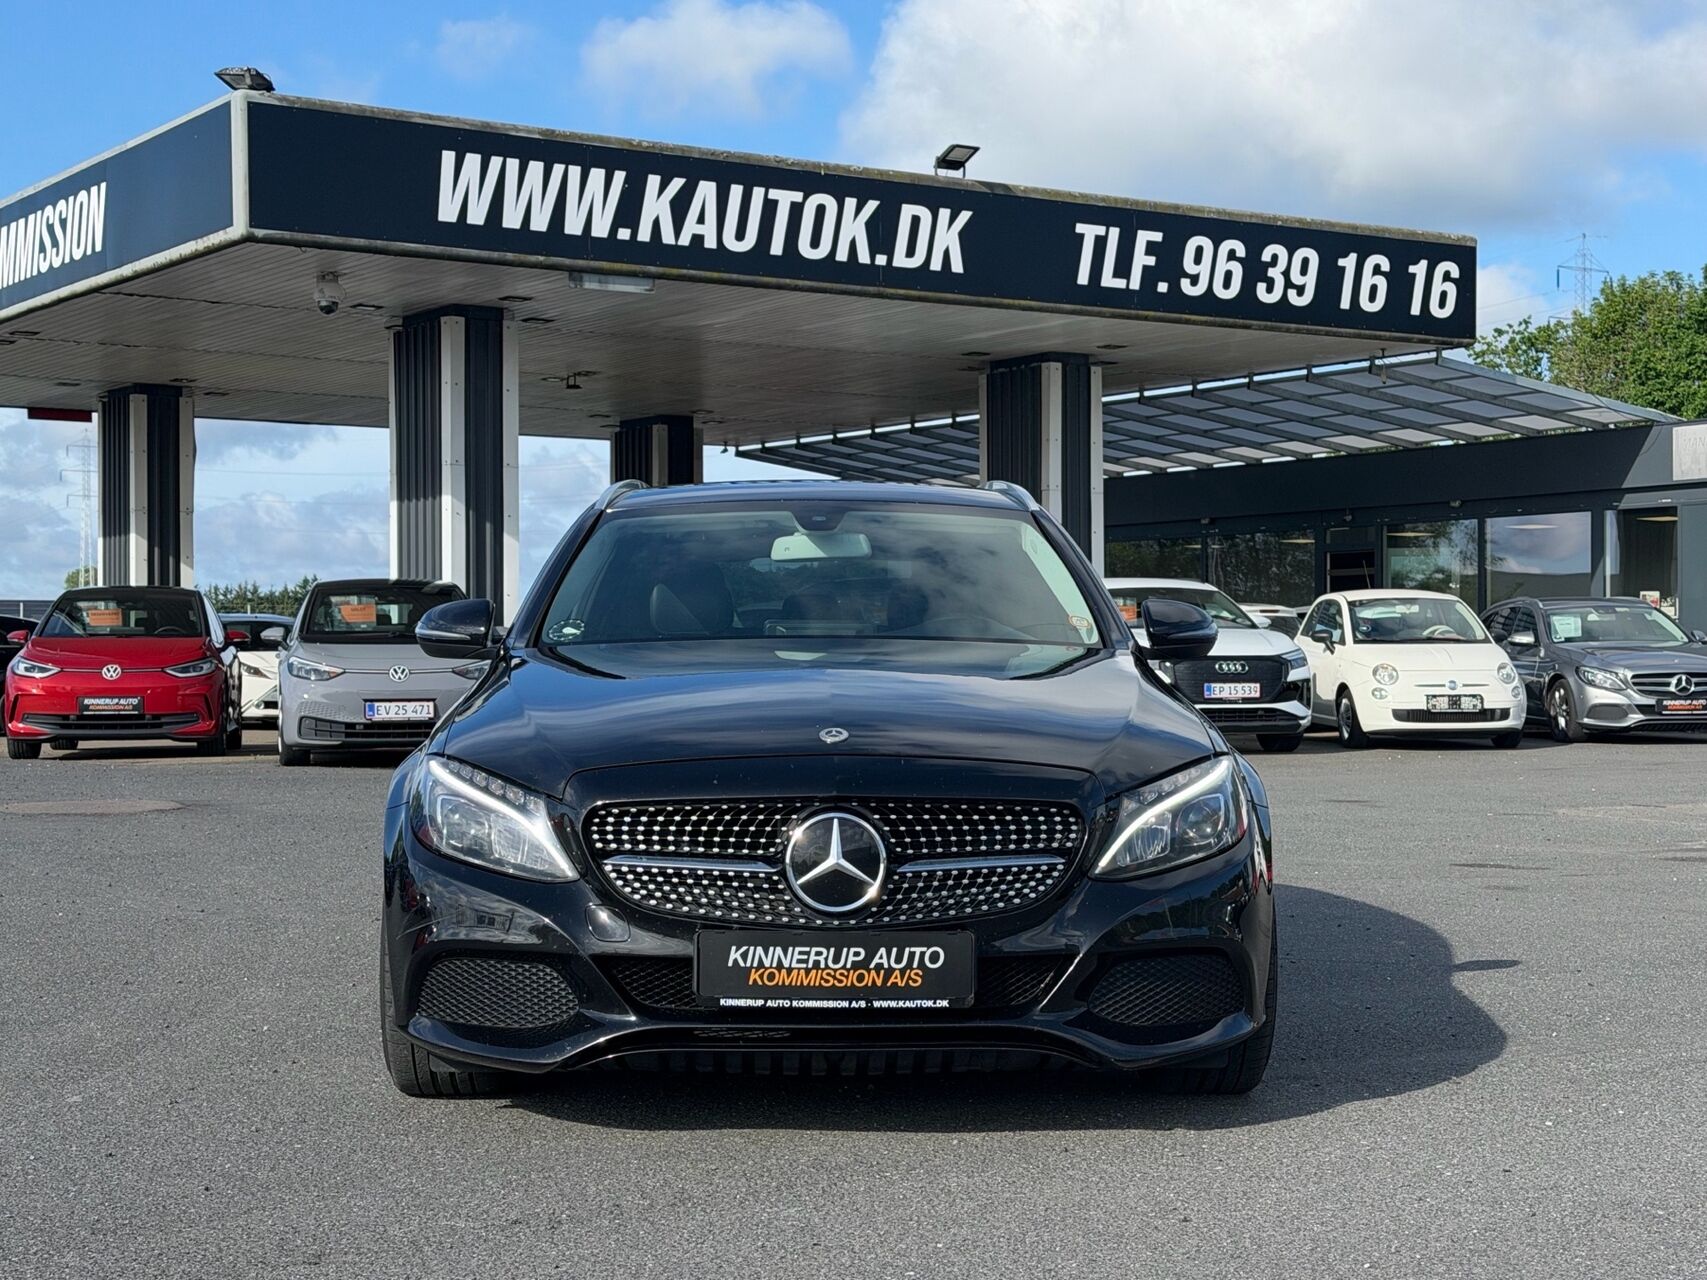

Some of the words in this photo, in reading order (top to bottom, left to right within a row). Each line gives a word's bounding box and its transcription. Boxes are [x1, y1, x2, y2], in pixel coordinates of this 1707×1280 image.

[437, 150, 973, 274] WWW.KAUTOK.DK
[1075, 223, 1169, 293] TLF.
[1180, 235, 1246, 300] 96
[1256, 243, 1319, 307] 39
[1337, 252, 1391, 313] 16
[1408, 259, 1460, 319] 16
[1212, 685, 1225, 696] EP
[1228, 685, 1239, 696] 15
[1241, 685, 1258, 696] 539
[376, 705, 391, 715] EV
[394, 705, 408, 715] 25
[411, 705, 432, 715] 471
[728, 945, 865, 968] KINNERUP
[870, 946, 945, 969] AUTO
[748, 968, 884, 987] KOMMISSION
[887, 969, 923, 987] A/S
[720, 998, 764, 1007] KINNERUP
[766, 999, 791, 1008] AUTO
[792, 999, 849, 1008] KOMMISSION
[851, 999, 866, 1008] A/S
[873, 999, 949, 1008] WWW.KAUTOK.DK
